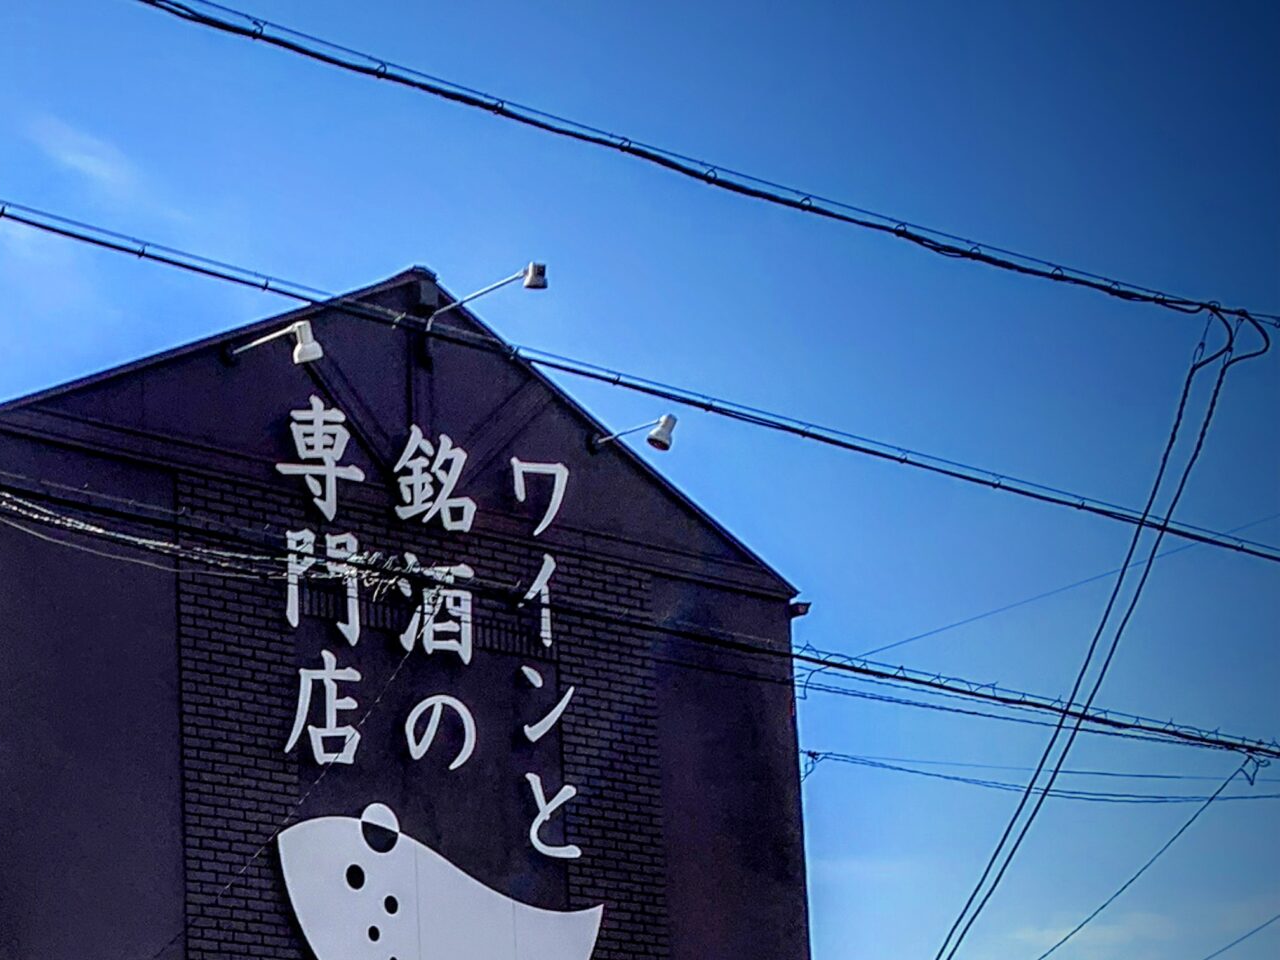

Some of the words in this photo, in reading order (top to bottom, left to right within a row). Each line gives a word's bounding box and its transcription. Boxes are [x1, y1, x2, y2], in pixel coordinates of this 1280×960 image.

[275, 394, 365, 767] 専門店
[393, 423, 478, 771] 銘酒の
[509, 455, 581, 860] ワインと
